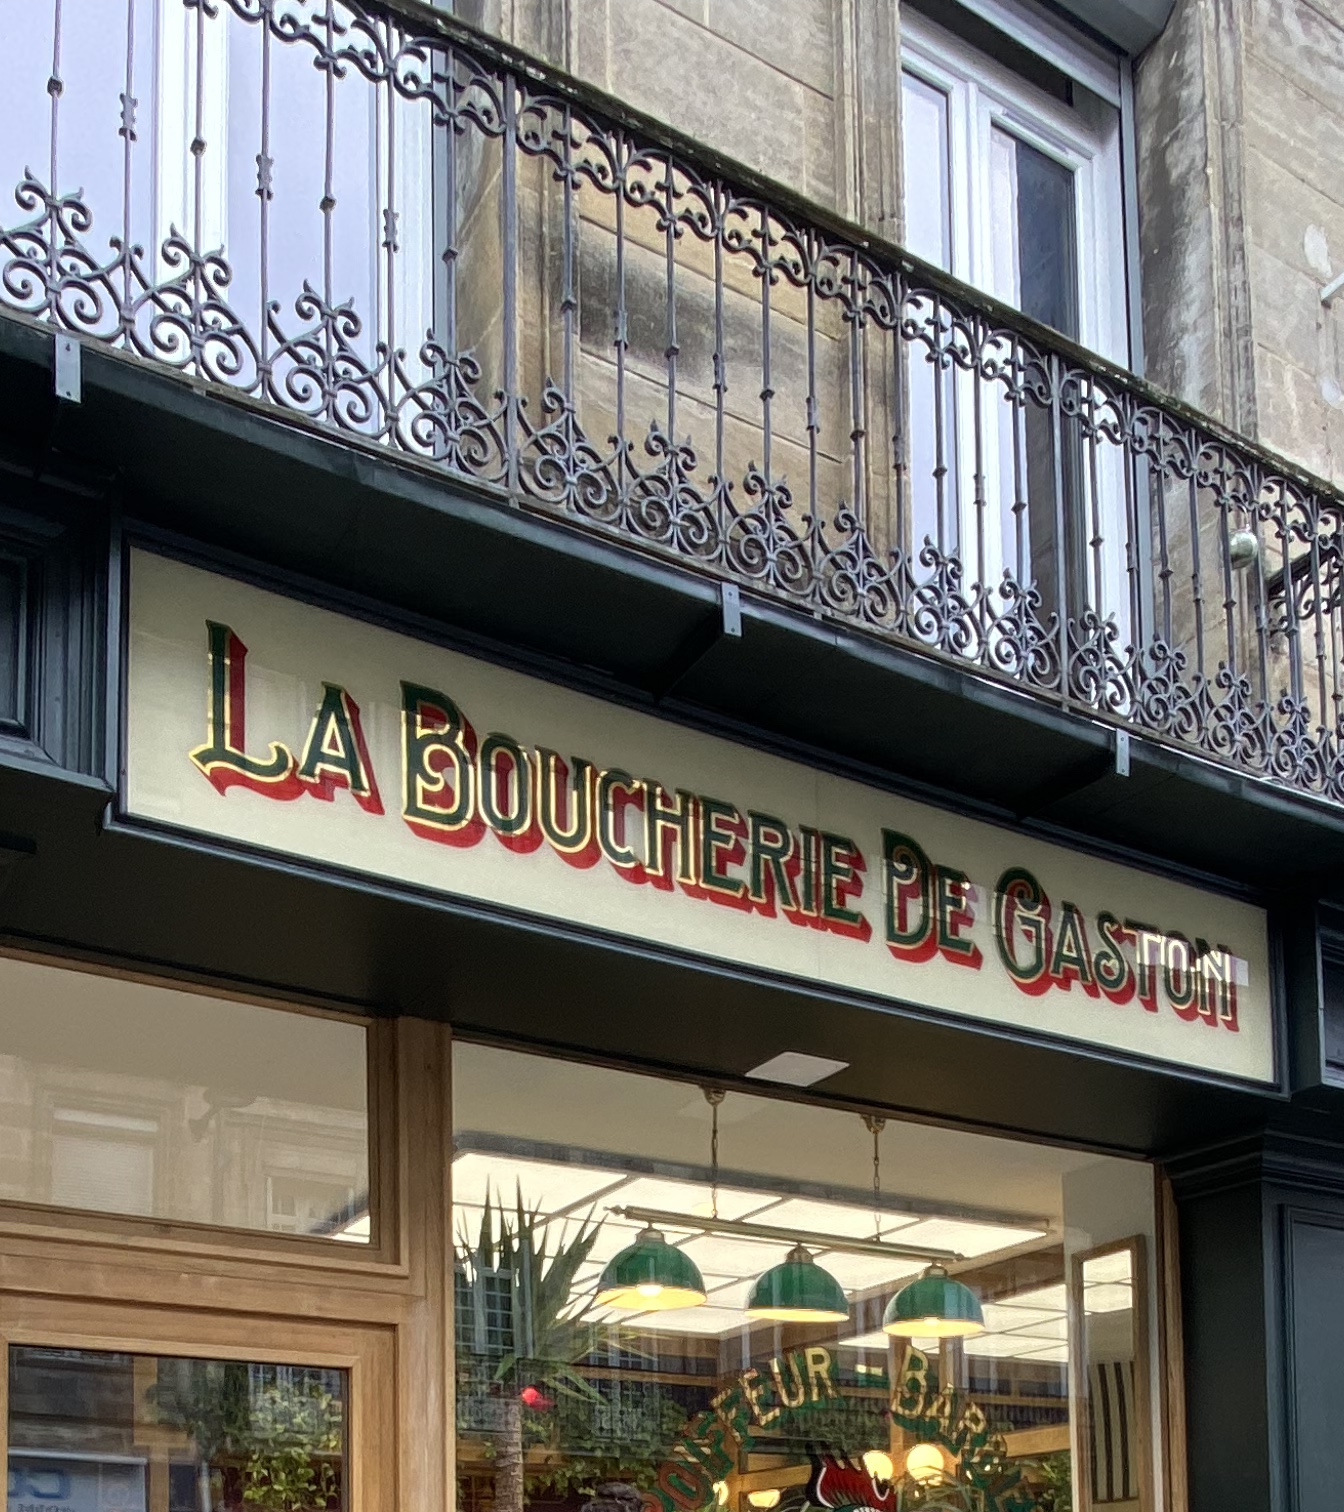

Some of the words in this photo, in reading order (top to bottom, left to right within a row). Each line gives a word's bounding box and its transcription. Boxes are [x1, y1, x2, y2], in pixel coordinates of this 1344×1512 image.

[187, 618, 384, 816] LA
[397, 679, 872, 941] BOUCHERIE
[880, 828, 985, 968] DE
[992, 864, 1240, 1033] GASTON
